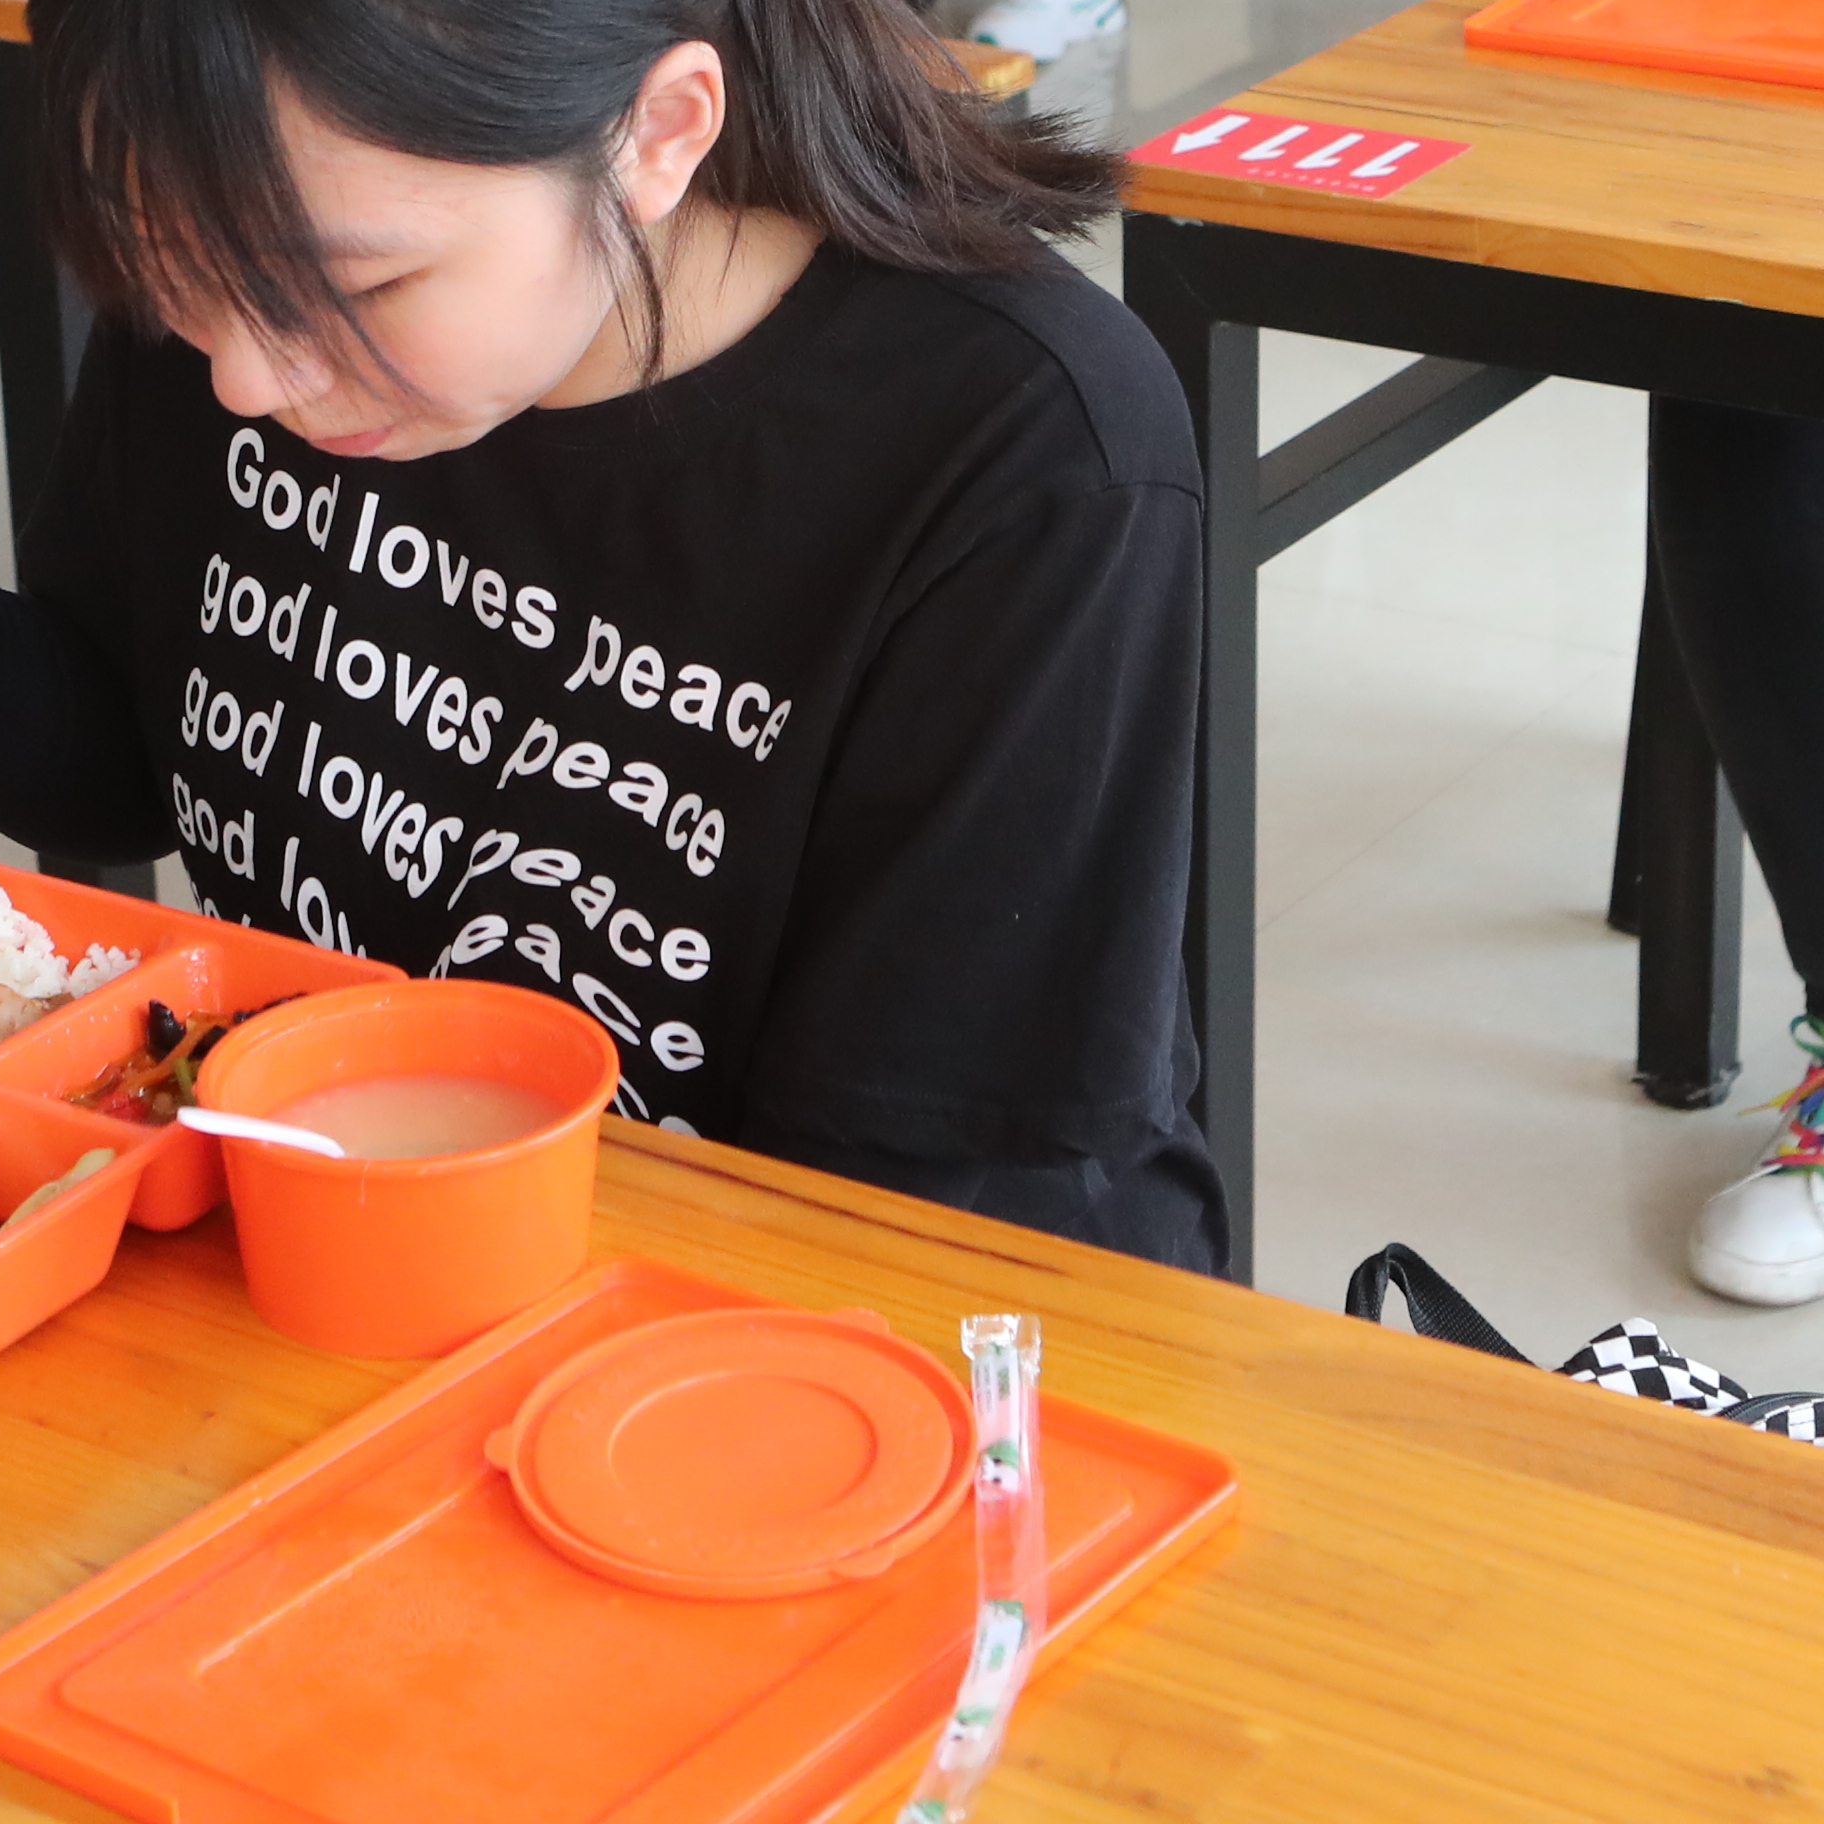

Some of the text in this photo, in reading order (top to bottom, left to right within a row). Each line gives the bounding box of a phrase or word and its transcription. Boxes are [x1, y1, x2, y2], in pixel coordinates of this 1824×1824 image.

[200, 553, 726, 877] god loves peace
[226, 427, 793, 762] God loves peace
[172, 772, 256, 881] god
[181, 667, 712, 982] god loves peace
